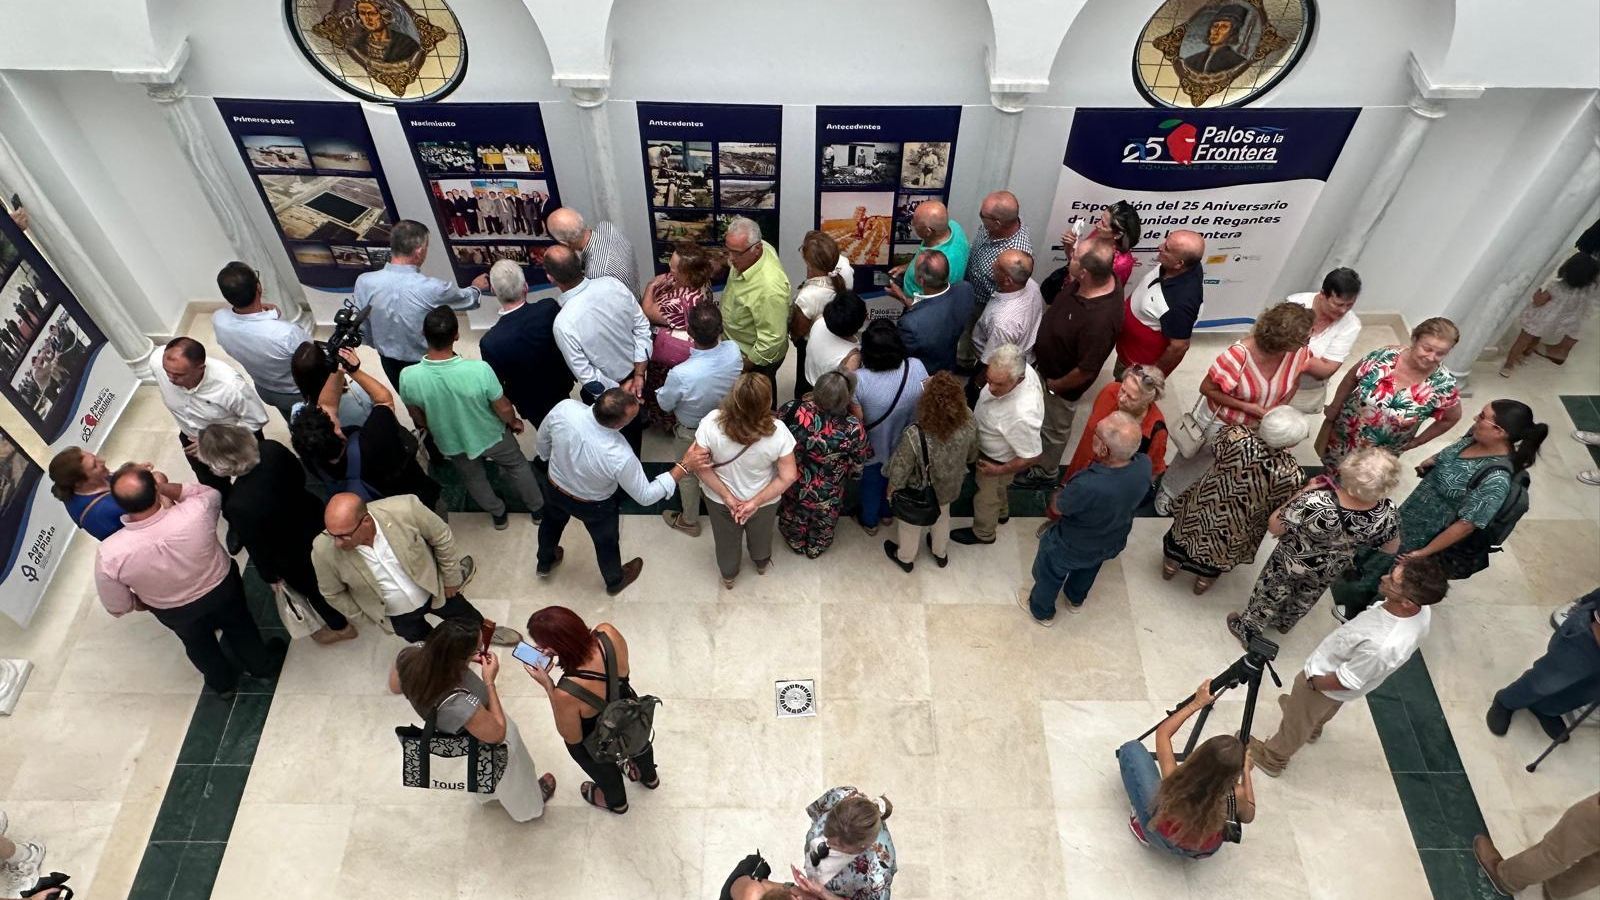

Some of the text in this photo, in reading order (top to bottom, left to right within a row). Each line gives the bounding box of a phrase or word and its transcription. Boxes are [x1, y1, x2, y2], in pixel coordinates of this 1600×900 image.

[649, 119, 704, 127] Antecedentes
[1200, 126, 1284, 144] Palos de la
[1122, 137, 1164, 163] 25
[1194, 144, 1277, 161] Frontera
[1155, 200, 1179, 211] del
[1181, 201, 1200, 211] 25
[1202, 200, 1288, 211] Aniversario
[1139, 215, 1189, 225] unidad
[1191, 215, 1210, 225] de
[1213, 215, 1281, 228] Regantes
[1143, 229, 1162, 239] de
[28, 529, 46, 560] Aguas
[34, 551, 44, 565] de
[40, 526, 56, 552] Plata
[432, 779, 465, 790] TOUS
